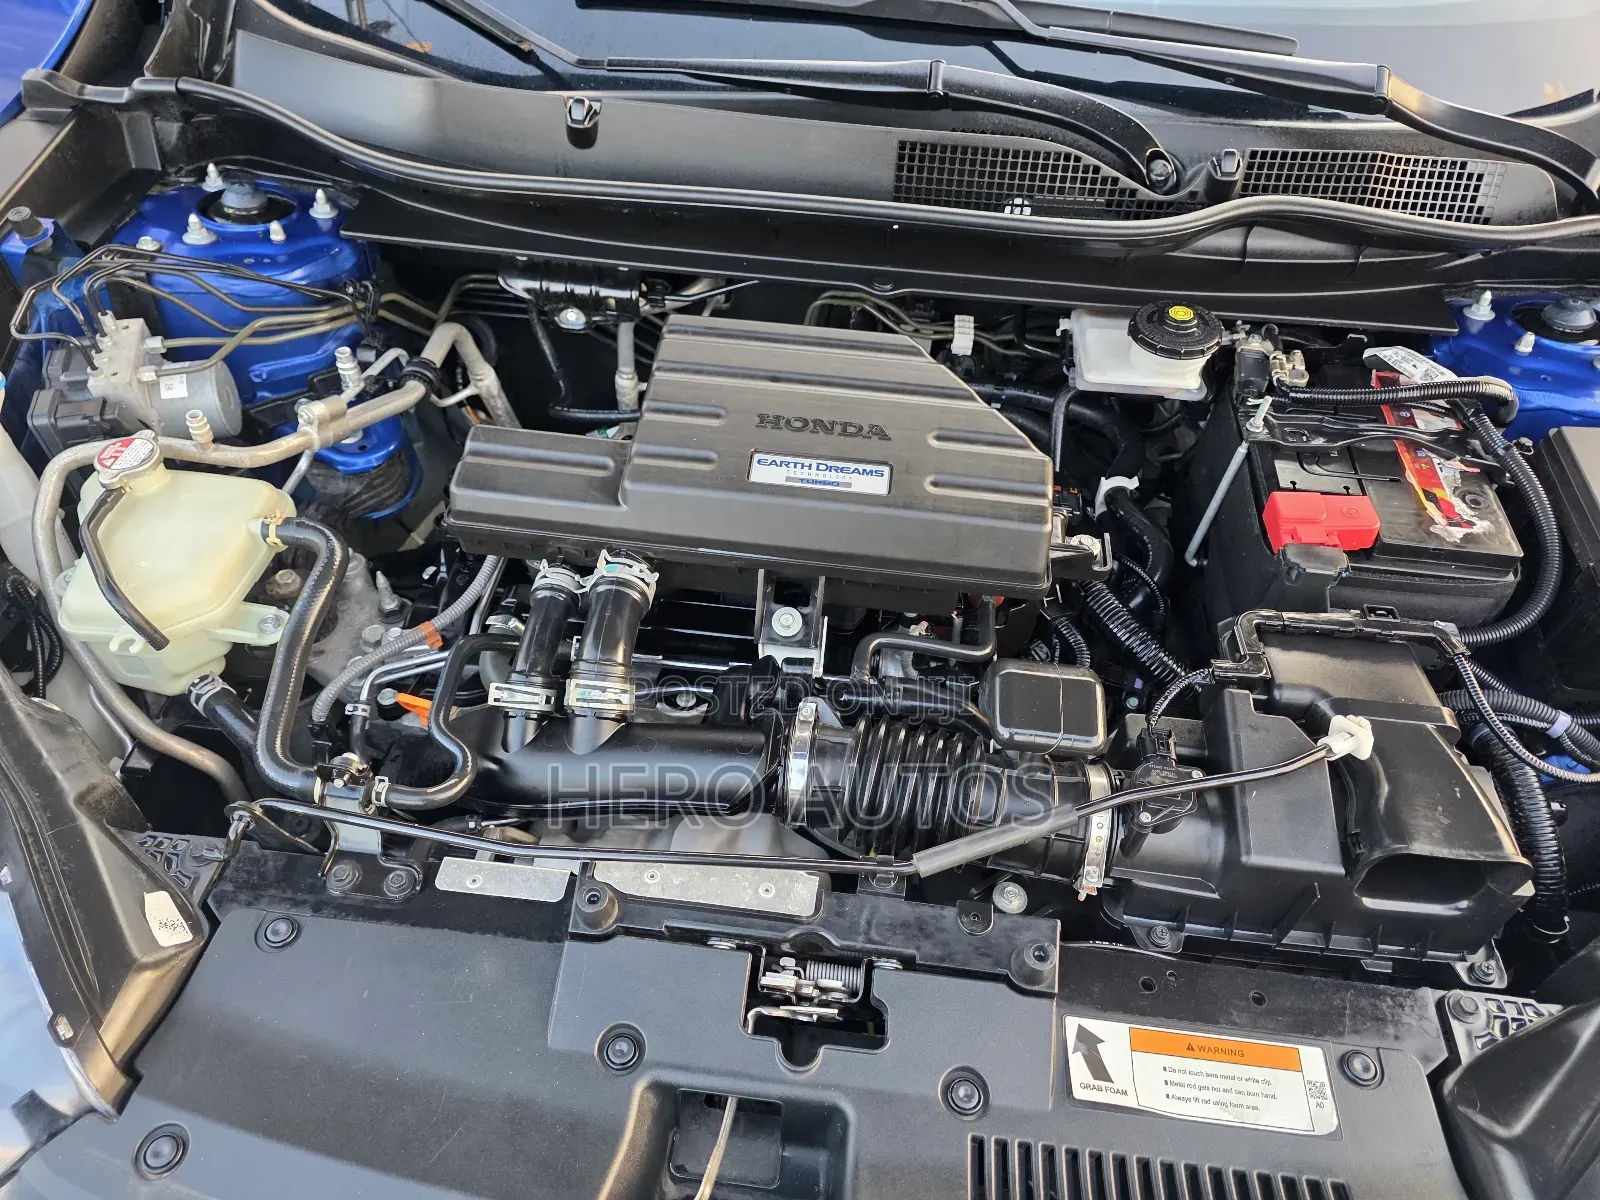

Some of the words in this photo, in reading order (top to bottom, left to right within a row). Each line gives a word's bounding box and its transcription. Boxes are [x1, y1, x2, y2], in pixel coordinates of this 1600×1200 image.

[755, 412, 892, 441] HONDA
[756, 458, 813, 471] EARTH
[815, 462, 885, 478] DREAMS
[786, 469, 853, 480] TECHNOLOGY
[1197, 1045, 1245, 1058] WARNING
[1244, 1076, 1260, 1084] white
[1080, 1082, 1103, 1092] GRAB
[1105, 1086, 1128, 1097] FOAM
[1171, 1093, 1192, 1104] Always
[1212, 1100, 1228, 1108] using
